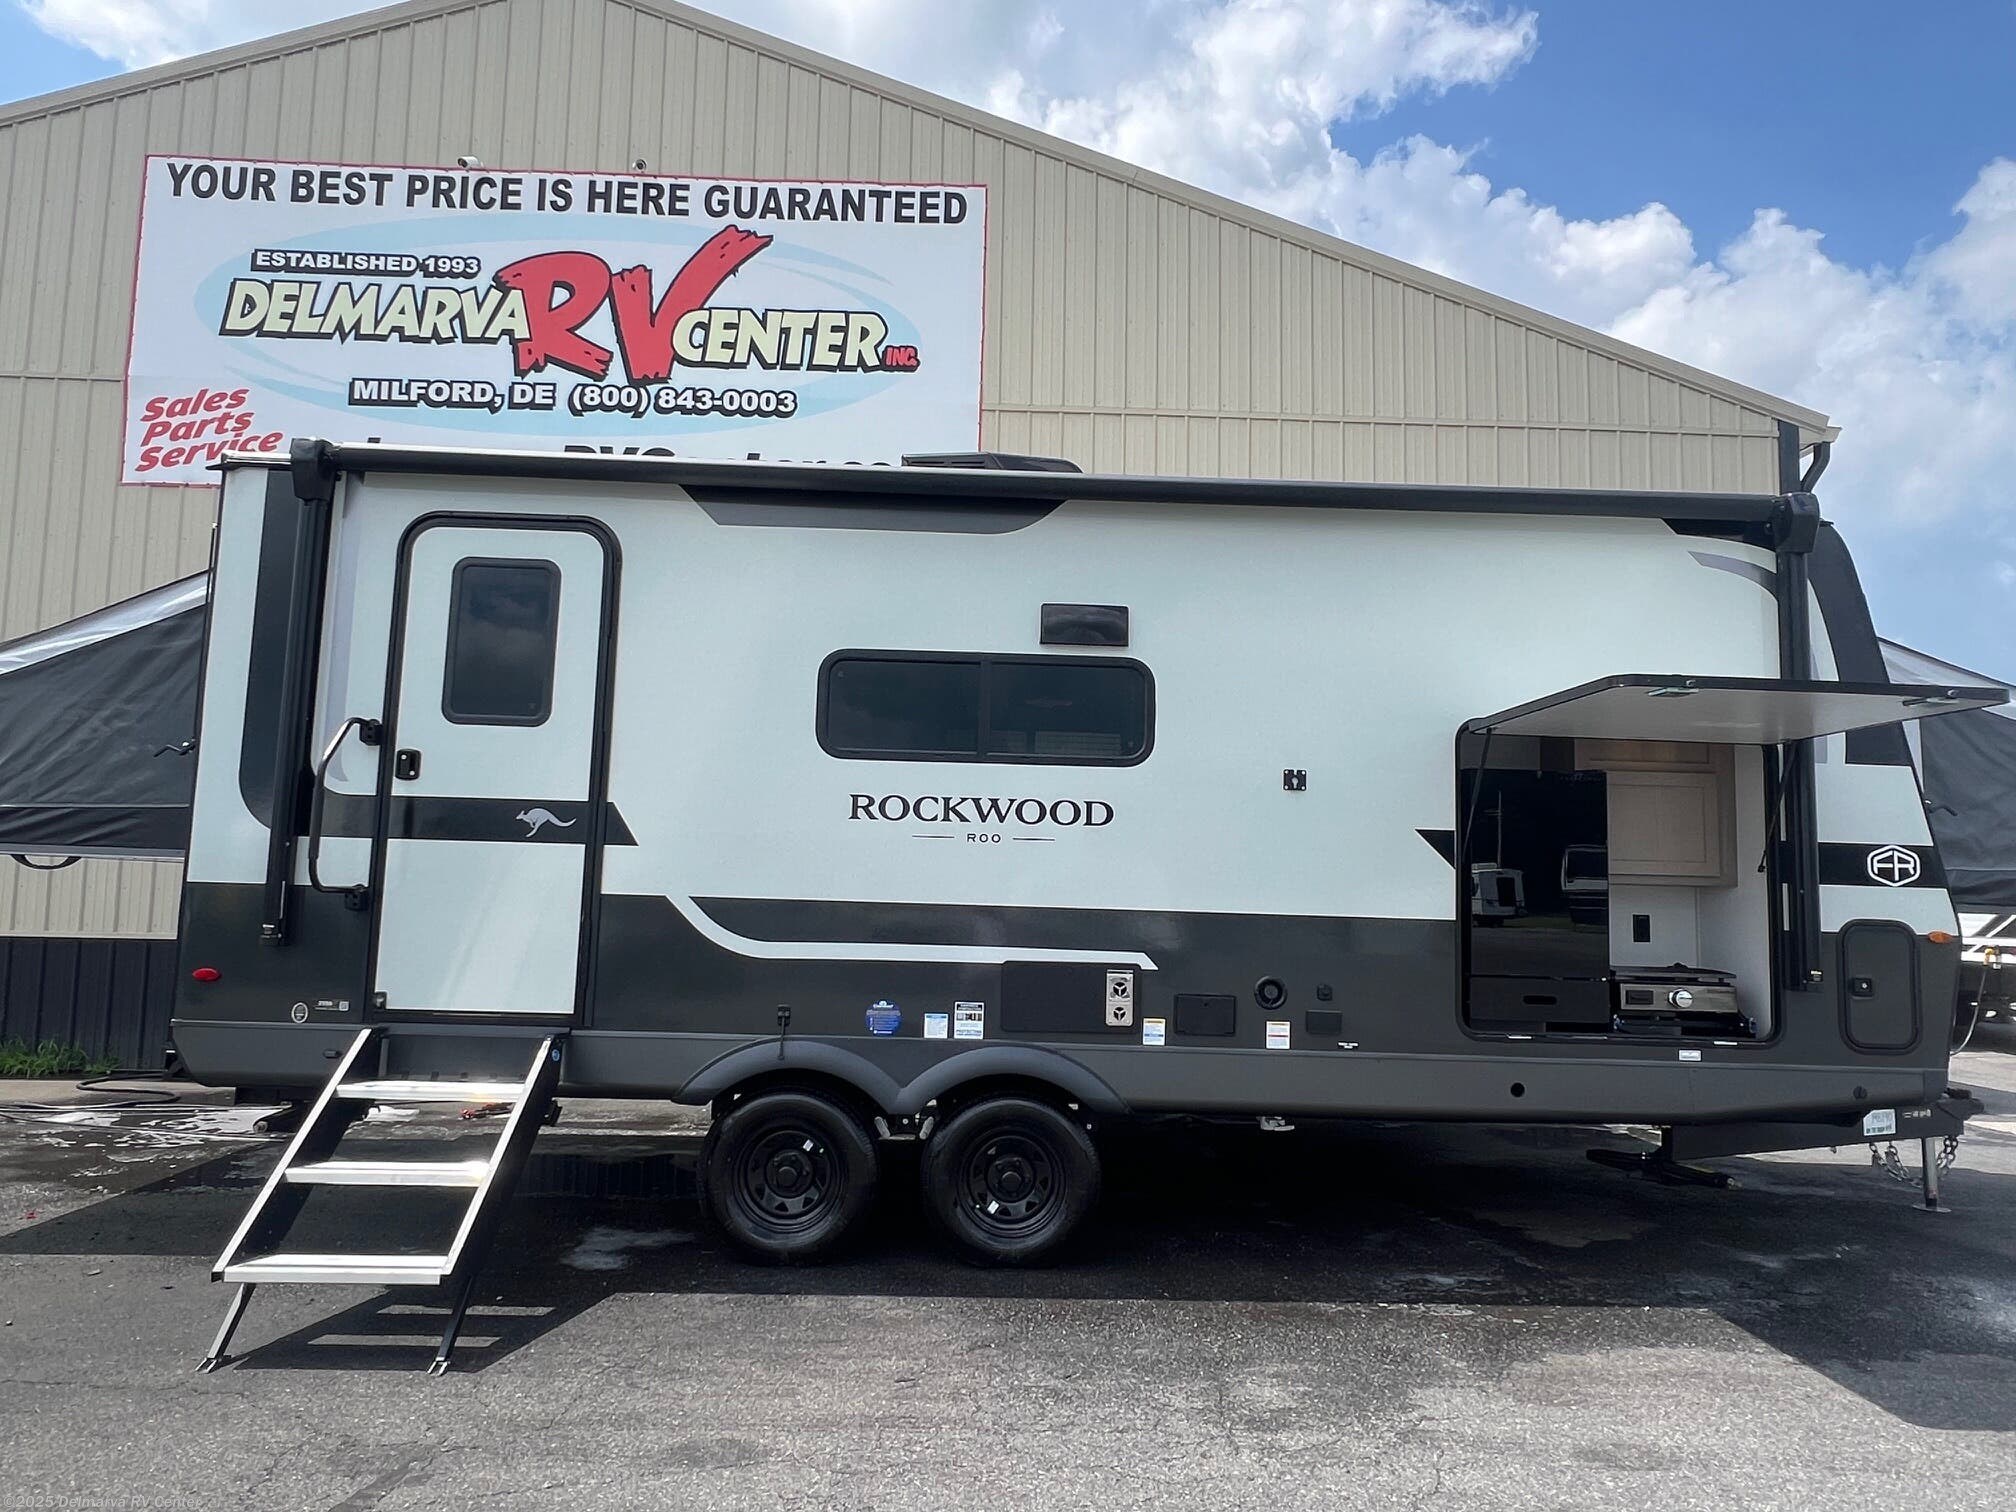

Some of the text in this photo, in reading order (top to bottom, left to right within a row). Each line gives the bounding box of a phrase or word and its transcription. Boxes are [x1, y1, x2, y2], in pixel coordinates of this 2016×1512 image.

[168, 162, 968, 224] YOUR BEST PRICE IS HERE GUARANTEED
[252, 250, 481, 277] ESTABLISHED 1993
[221, 225, 920, 384] DELMARVA RV CENTER INC.
[141, 388, 250, 422] Sales
[352, 379, 798, 417] MILFORD, DE (800) 843-0003
[141, 412, 254, 447] Parts
[135, 432, 283, 472] Service
[848, 793, 1115, 827] ROCKWOOD
[966, 832, 1002, 844] ROO
